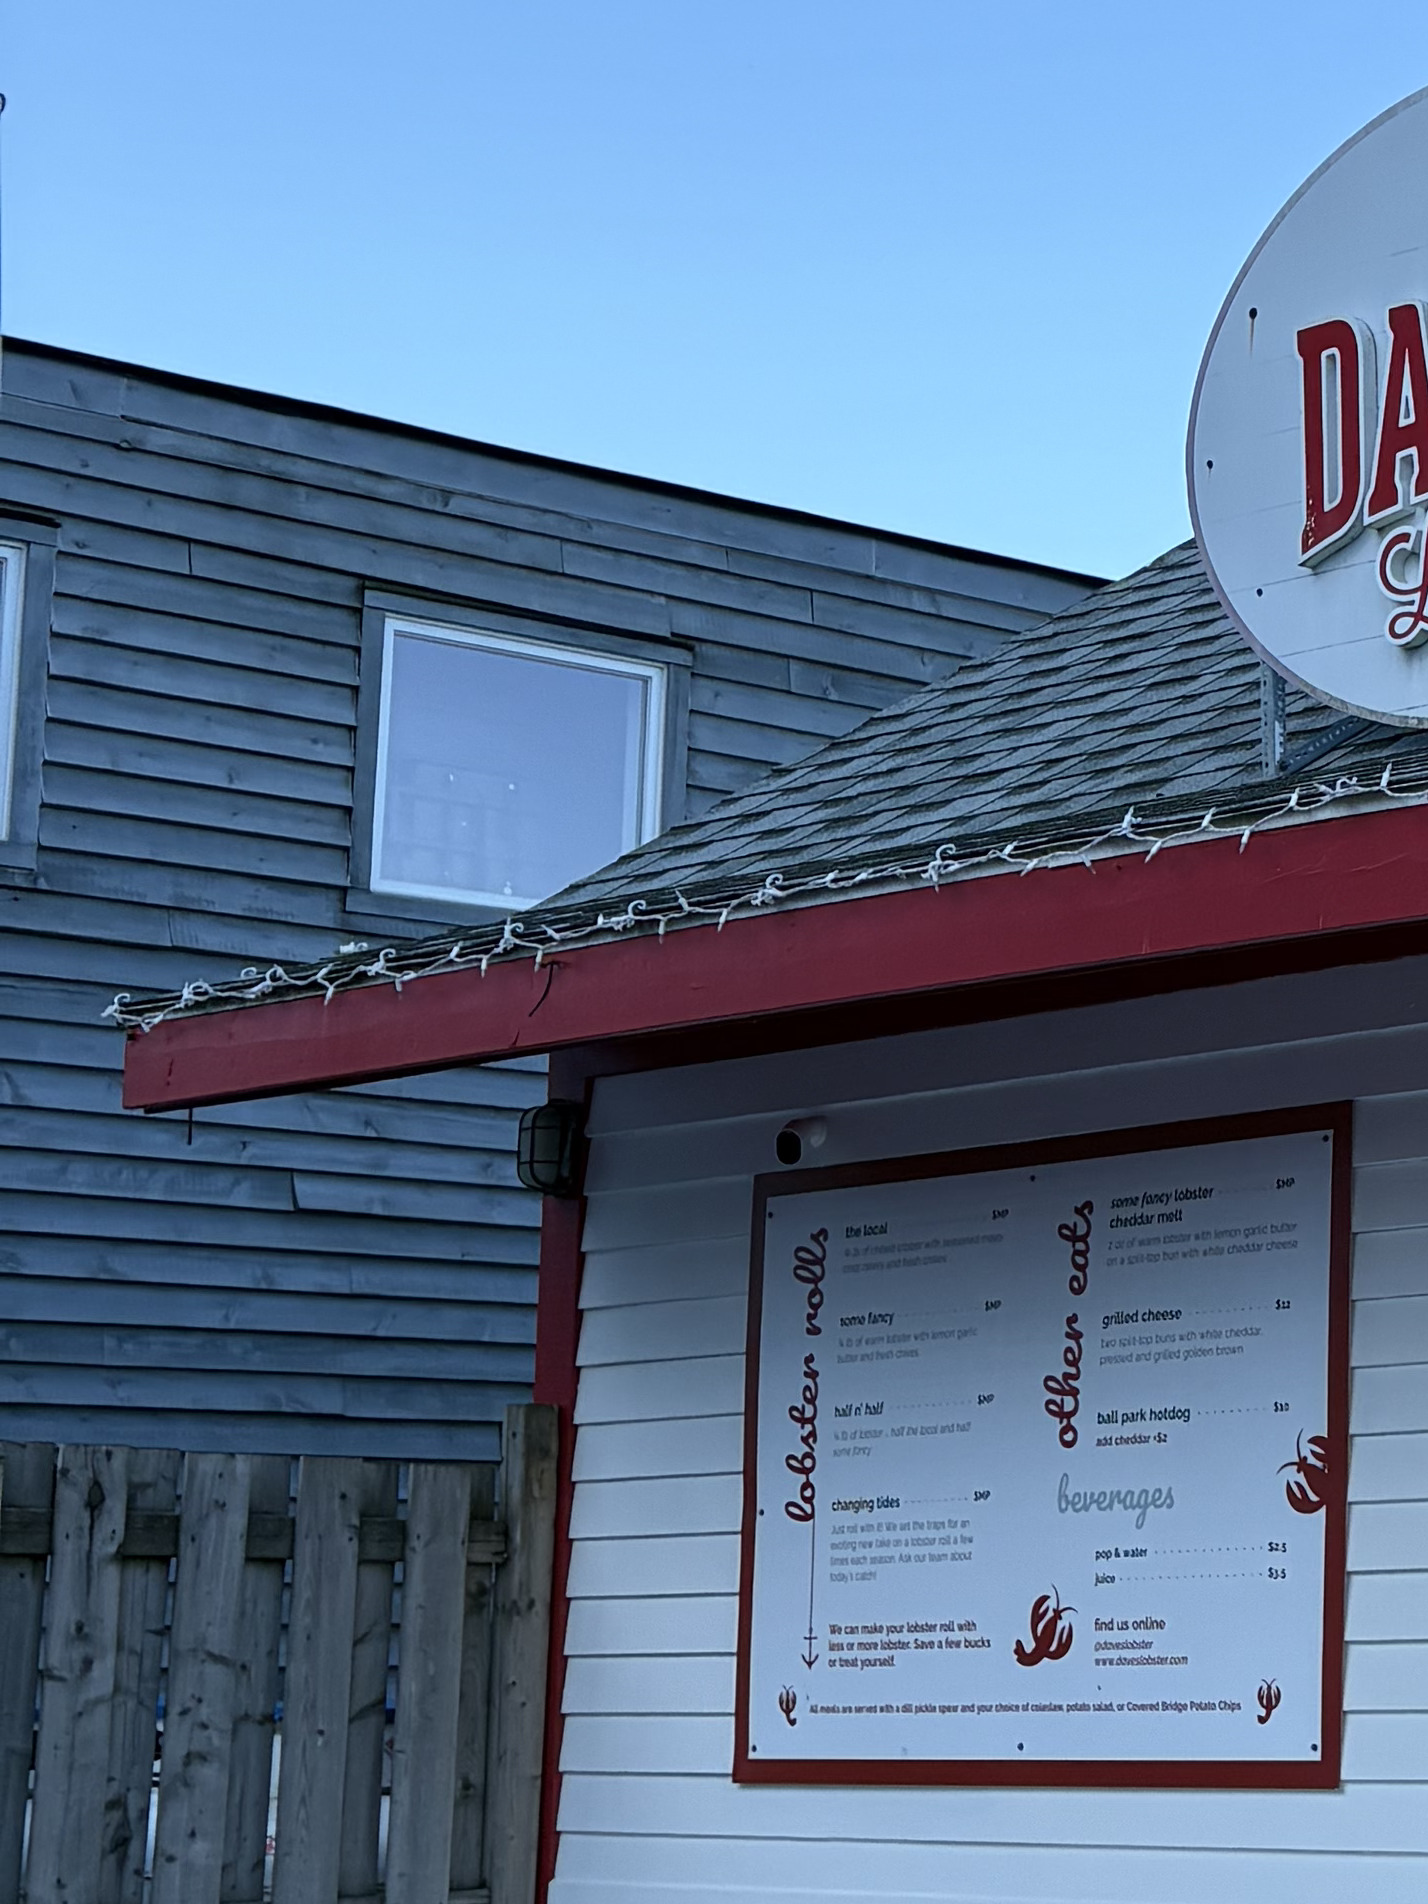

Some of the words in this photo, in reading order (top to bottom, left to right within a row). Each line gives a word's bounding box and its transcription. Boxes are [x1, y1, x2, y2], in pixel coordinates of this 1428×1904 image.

[1111, 1196, 1138, 1208] some
[1141, 1191, 1171, 1208] fancy
[1174, 1187, 1213, 1201] lobster
[1110, 1213, 1154, 1228] cheddar
[1157, 1208, 1182, 1222] melt
[846, 1227, 861, 1238] the
[864, 1222, 887, 1236] local
[1214, 1227, 1241, 1238] lemon
[1057, 1200, 1094, 1296] eats
[1227, 1242, 1262, 1254] cheddar
[1266, 1239, 1297, 1251] cheese
[793, 1227, 828, 1337] rolls
[840, 1316, 865, 1327] some
[868, 1312, 895, 1325] fancy
[1102, 1310, 1138, 1329] grilled
[1141, 1309, 1181, 1322] cheese
[1135, 1350, 1151, 1361] and
[1153, 1348, 1180, 1363] grilled
[1182, 1346, 1213, 1361] golden
[1216, 1345, 1244, 1356] brown
[1043, 1313, 1084, 1449] other
[834, 1404, 852, 1417] half
[865, 1401, 884, 1415] half
[1097, 1410, 1118, 1424] ball
[1121, 1408, 1146, 1425] park
[1150, 1406, 1190, 1423] hotdog
[785, 1353, 819, 1522] lobster
[1096, 1434, 1112, 1446] add
[1115, 1433, 1150, 1445] cheddar
[832, 1498, 874, 1513] changing
[877, 1495, 900, 1509] tides
[1057, 1472, 1174, 1530] beverages
[1095, 1549, 1112, 1561] pop
[1123, 1547, 1147, 1558] water
[1094, 1572, 1115, 1586] juice
[829, 1624, 842, 1635] We
[844, 1625, 859, 1634] can
[861, 1622, 884, 1634] make
[886, 1625, 904, 1636] your
[907, 1620, 937, 1633] lobster
[939, 1620, 955, 1632] roll
[957, 1619, 977, 1631] with
[1094, 1617, 1113, 1631] find
[1117, 1620, 1129, 1630] us
[1132, 1616, 1165, 1630] online
[846, 1641, 854, 1651] or
[857, 1641, 878, 1651] more
[914, 1638, 935, 1649] Save
[937, 1639, 943, 1649] a
[945, 1637, 961, 1648] few
[963, 1637, 991, 1648] bucks
[828, 1658, 836, 1667] or
[838, 1657, 858, 1667] treat
[1095, 1654, 1188, 1667] www.daveslobster.com
[1116, 1703, 1124, 1711] or
[1127, 1701, 1159, 1712] Covered
[1161, 1701, 1188, 1713] Bridge
[1190, 1701, 1216, 1712] Potato
[1218, 1700, 1241, 1713] Chips
